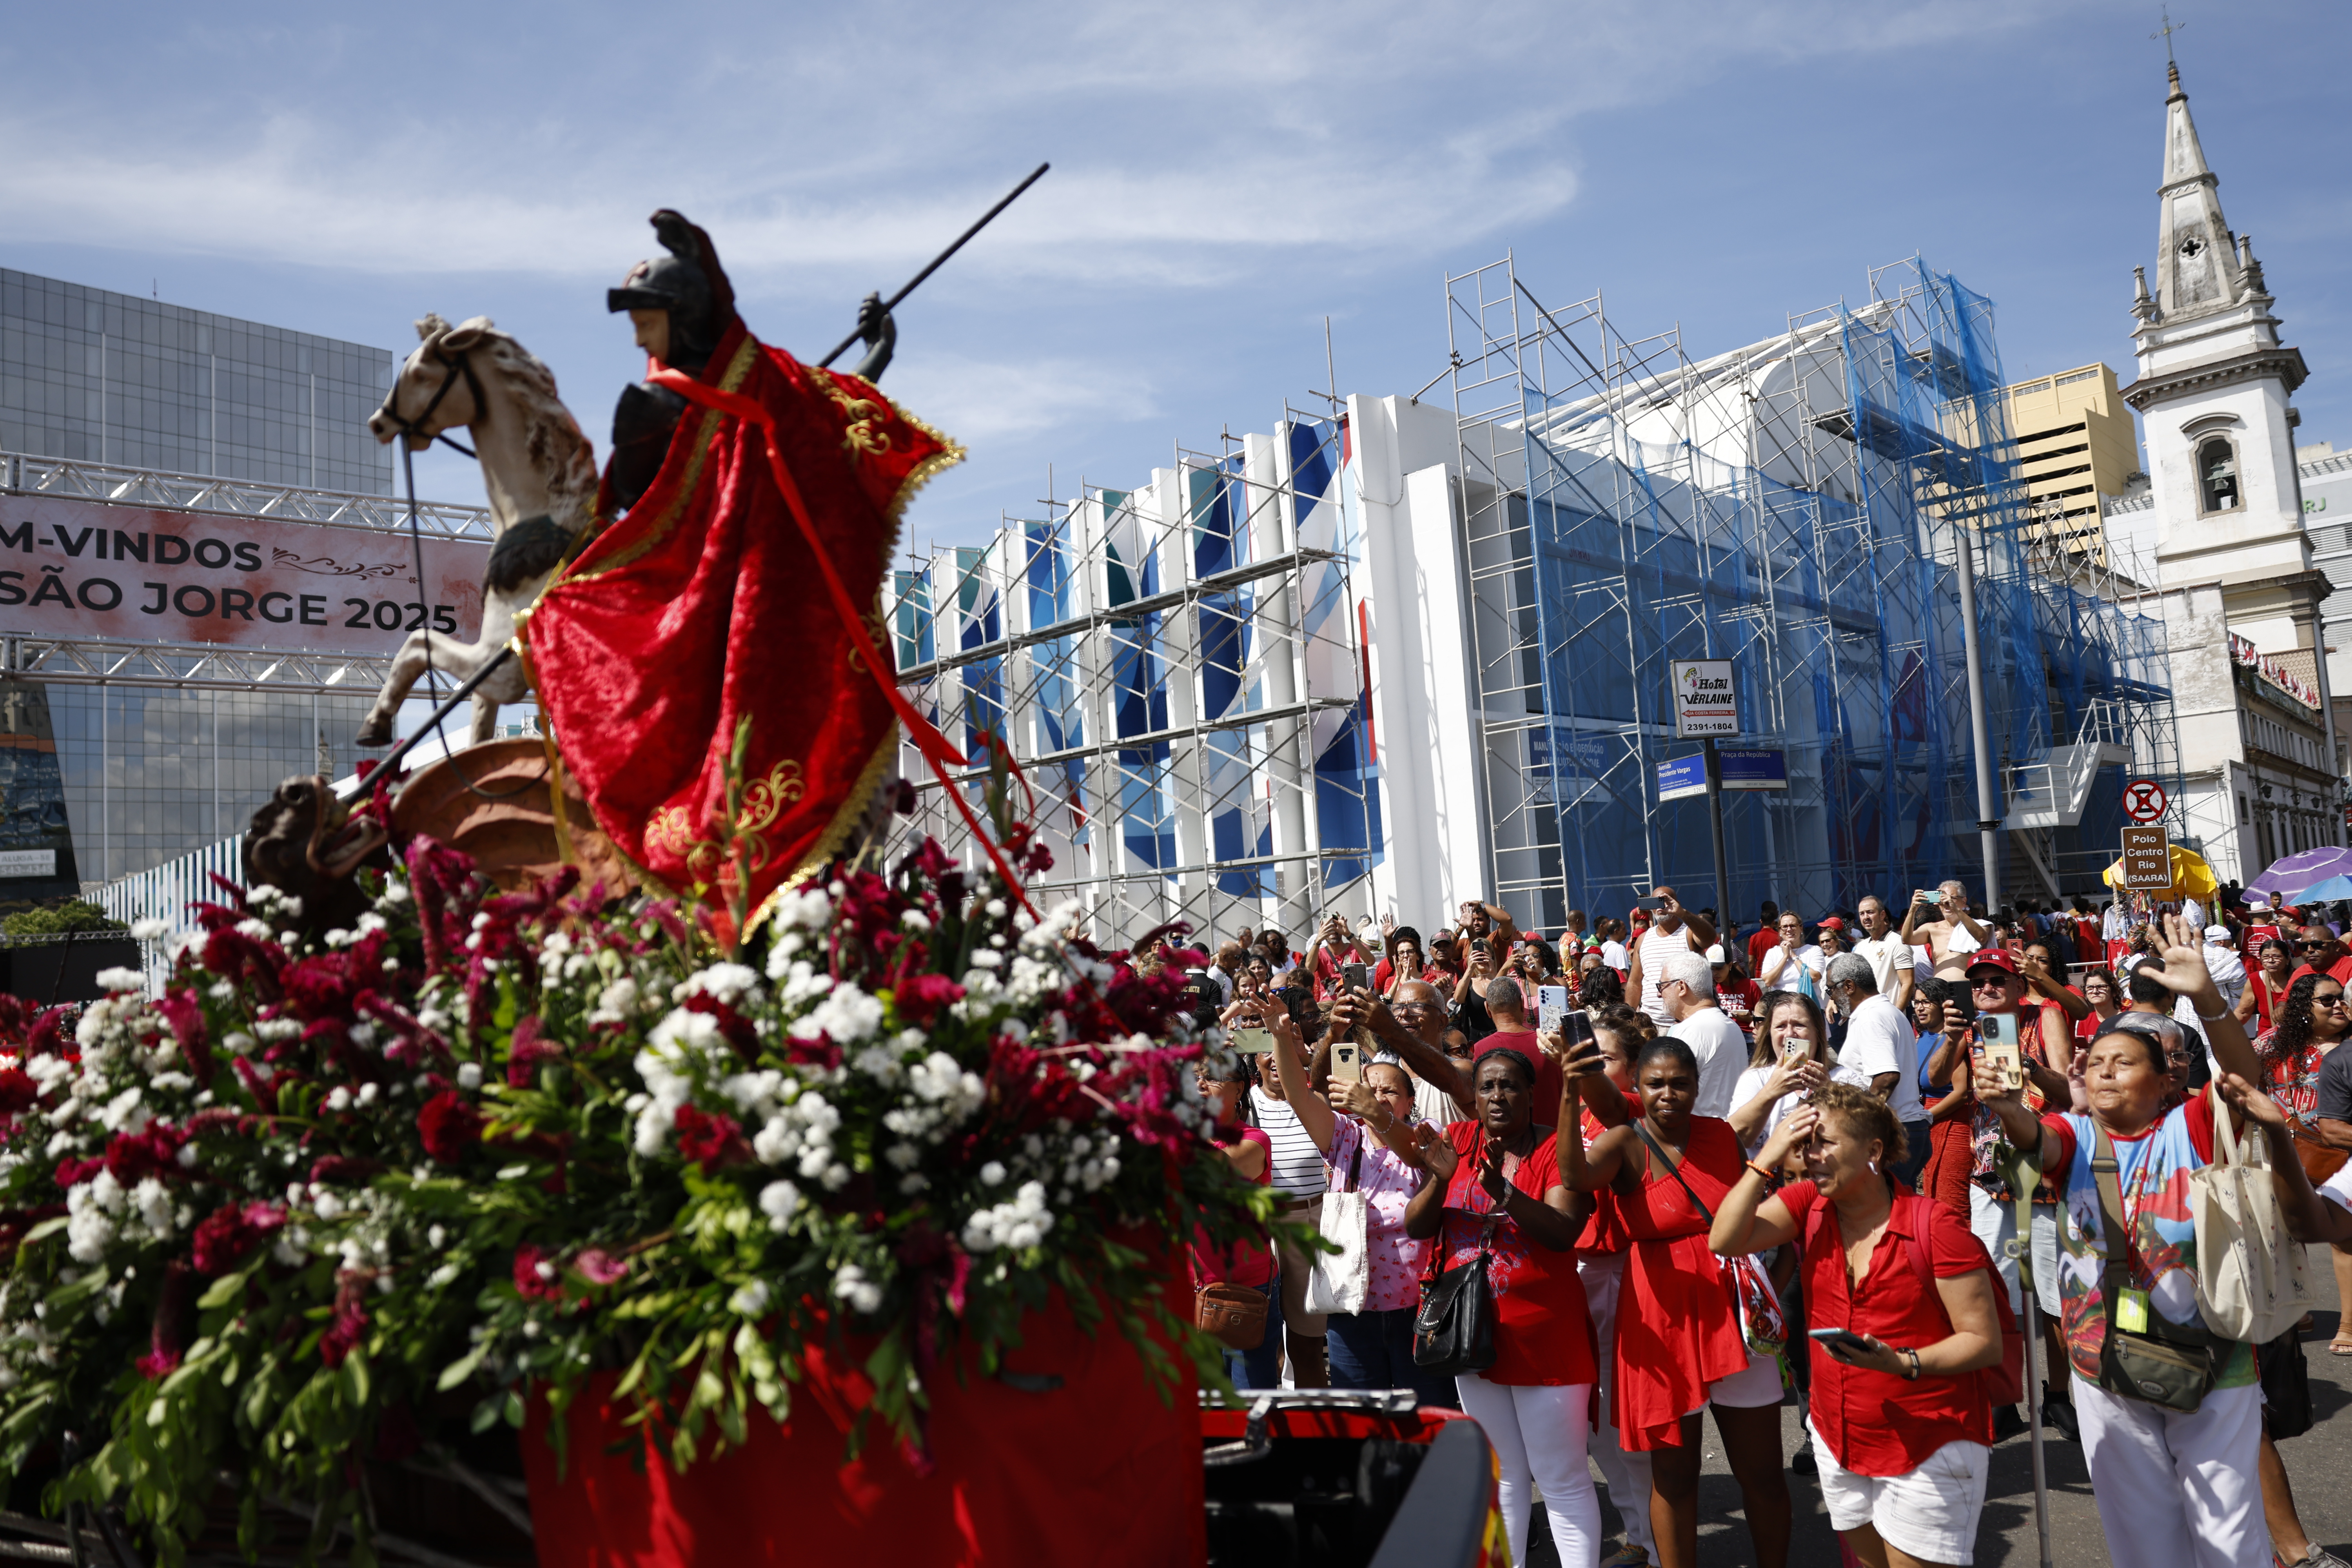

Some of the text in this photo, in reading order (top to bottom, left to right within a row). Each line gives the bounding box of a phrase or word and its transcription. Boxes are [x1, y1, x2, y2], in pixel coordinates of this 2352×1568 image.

[0, 564, 457, 634] SÃO JORGE 2025
[1698, 678, 1728, 690] Hotel
[1680, 693, 1733, 704] VERLAINE
[1658, 762, 1671, 771] Avenida
[1659, 769, 1677, 778] Presidente
[2132, 835, 2156, 843] Polo
[2127, 848, 2163, 857] Centro
[2138, 861, 2156, 869] Rio
[2128, 874, 2167, 884] (SAARA)
